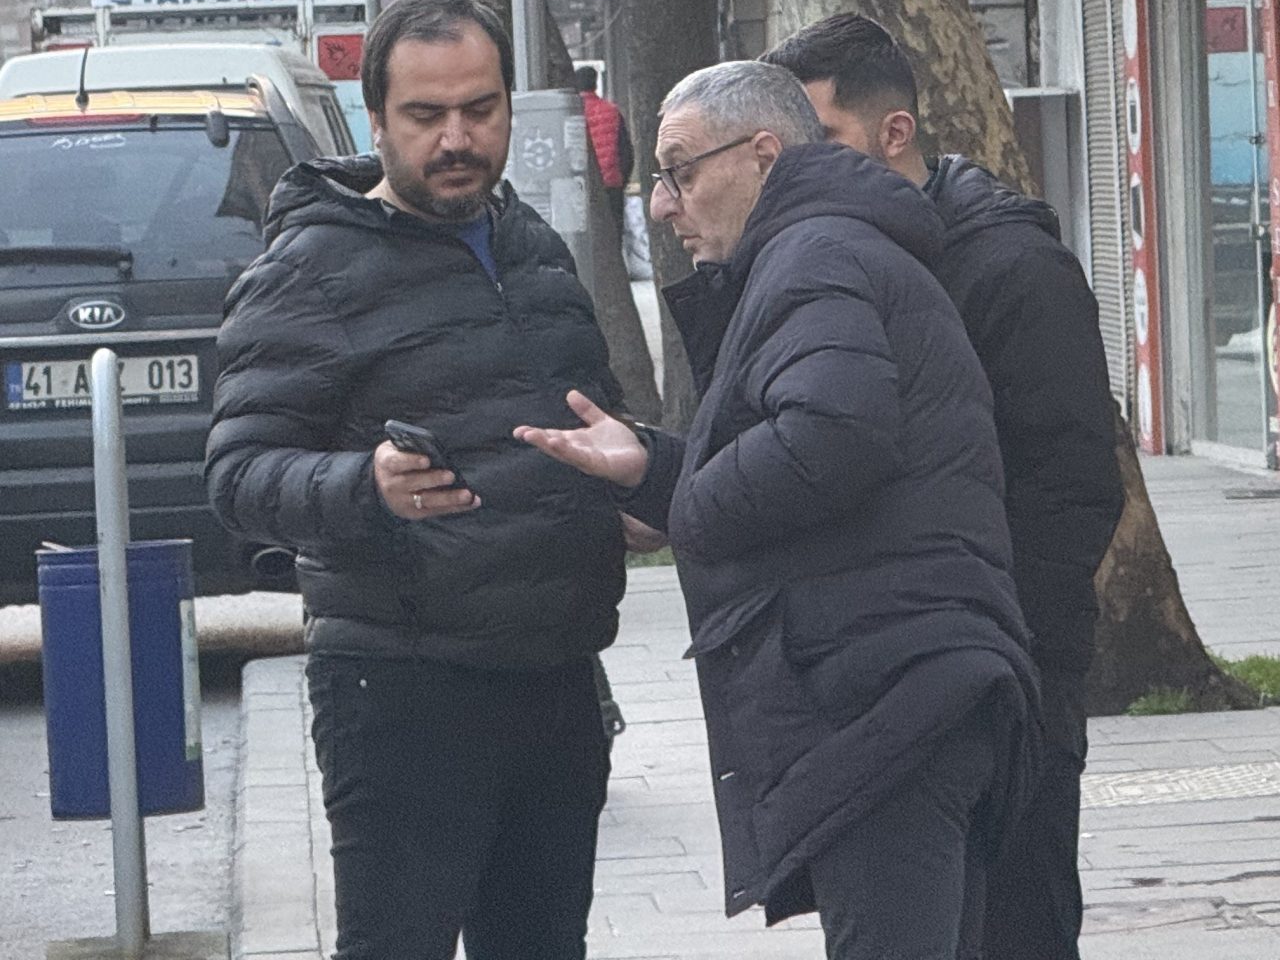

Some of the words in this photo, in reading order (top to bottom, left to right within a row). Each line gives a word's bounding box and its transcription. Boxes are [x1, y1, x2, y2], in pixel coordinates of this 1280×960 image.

[79, 306, 116, 323] KIA
[25, 365, 52, 396] 41
[148, 359, 193, 390] 013
